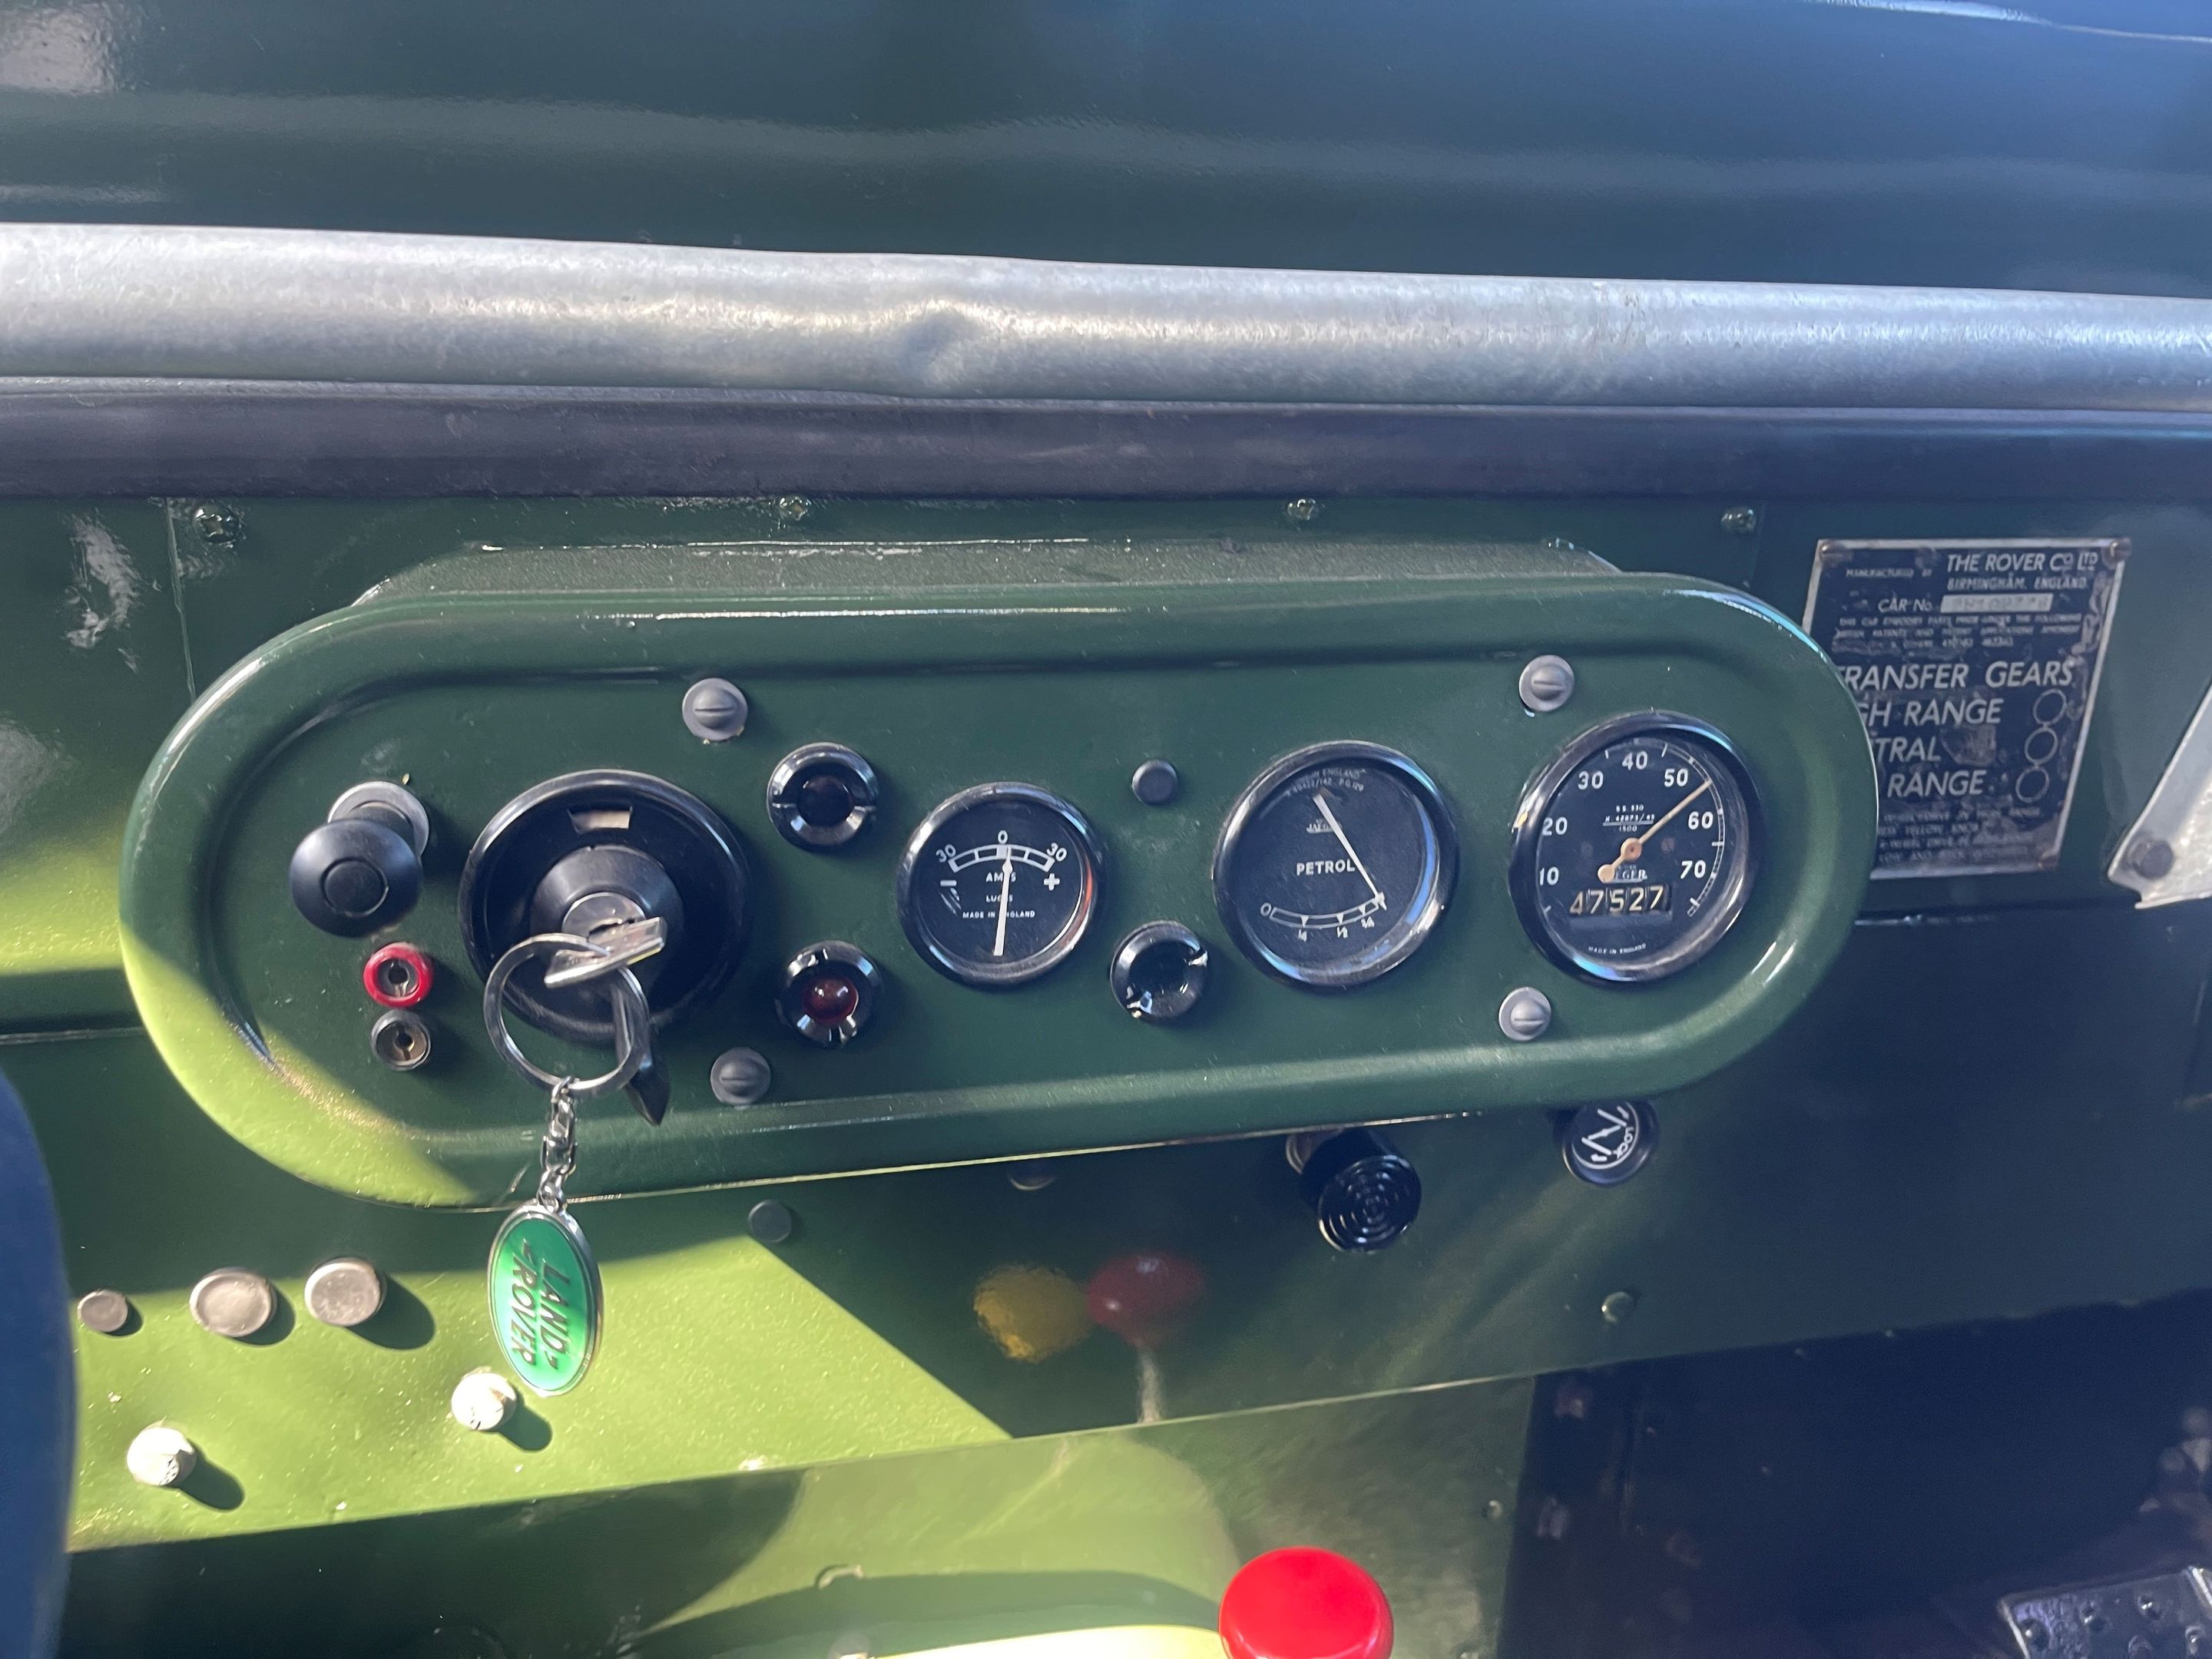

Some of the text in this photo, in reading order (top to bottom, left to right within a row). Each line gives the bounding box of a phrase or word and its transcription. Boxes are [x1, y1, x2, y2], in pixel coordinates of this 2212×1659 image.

[1947, 554, 1981, 572] THE
[1985, 553, 2046, 572] ROVER
[1985, 660, 2075, 688] GEARS
[1902, 697, 2005, 727] RANGE
[1621, 750, 1648, 770] 40
[1577, 770, 1604, 790] 30
[1664, 768, 1689, 787] 50
[1887, 769, 1988, 798] RANGE
[1541, 817, 1568, 836] 20
[1687, 810, 1714, 830] 60
[935, 843, 957, 863] 30
[1046, 842, 1068, 862] 30
[985, 872, 1017, 882] AMS
[1296, 858, 1356, 876] PETROL
[1538, 866, 1560, 886] 10
[1680, 859, 1707, 880] 70
[985, 894, 1014, 903] LUCS
[1569, 885, 1664, 916] 47527
[962, 911, 985, 919] MADE
